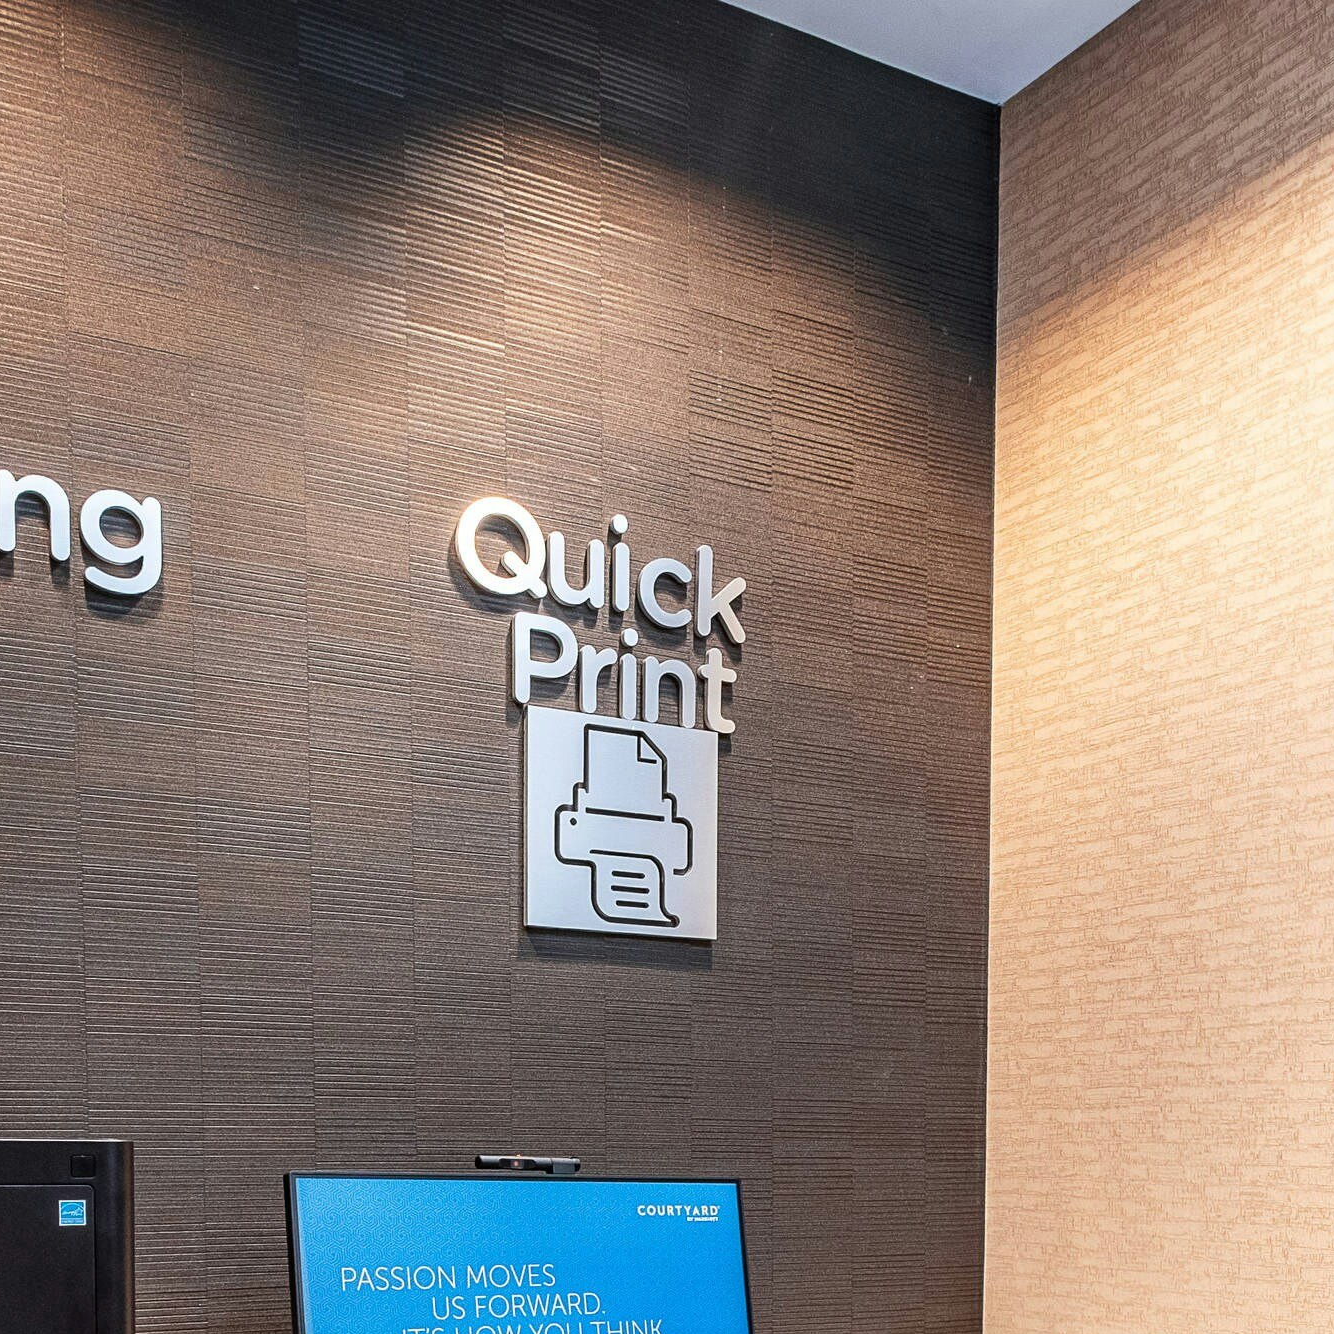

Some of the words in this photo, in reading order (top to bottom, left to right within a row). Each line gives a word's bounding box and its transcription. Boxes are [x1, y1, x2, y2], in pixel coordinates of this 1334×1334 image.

[454, 496, 747, 645] Quick
[511, 611, 737, 735] Print
[637, 1204, 719, 1217] COURTYARD
[340, 1264, 456, 1292] PASSION
[465, 1263, 556, 1289] MOVES
[431, 1296, 466, 1321] US
[473, 1292, 606, 1319] FORWARD.
